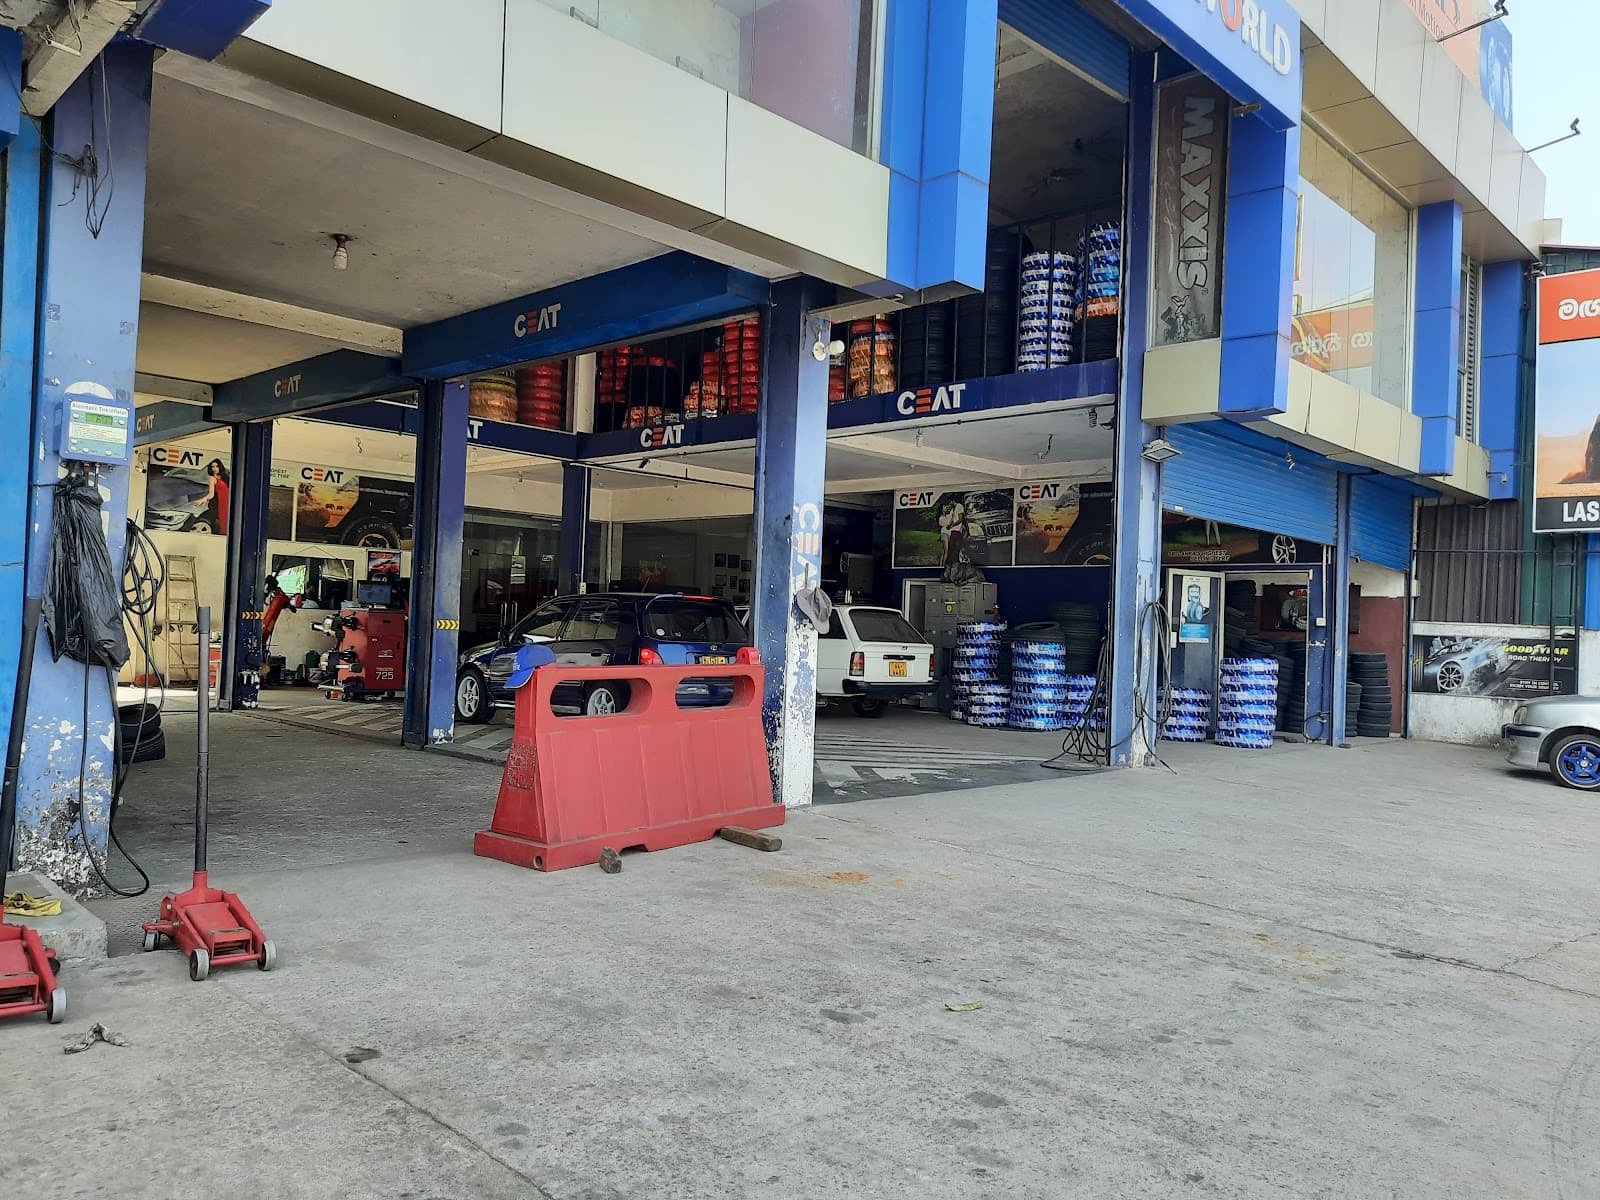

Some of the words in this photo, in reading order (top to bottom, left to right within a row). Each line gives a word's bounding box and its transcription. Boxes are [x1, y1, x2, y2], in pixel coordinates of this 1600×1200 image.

[1196, 0, 1291, 76] ORLD
[1177, 96, 1215, 290] MAXXIS
[514, 303, 561, 337] CEAT
[274, 374, 302, 398] CEAT
[897, 383, 966, 415] CEAT
[136, 414, 155, 432] CEAT
[640, 424, 685, 448] CEAT
[153, 447, 204, 467] CEAT
[301, 467, 344, 484] CEAT
[899, 491, 934, 507] CEAT
[1019, 483, 1060, 500] CEAT
[1563, 500, 1600, 522] LAS
[797, 502, 820, 592] CEA
[1507, 654, 1528, 662] ROAD
[375, 671, 394, 680] 725
